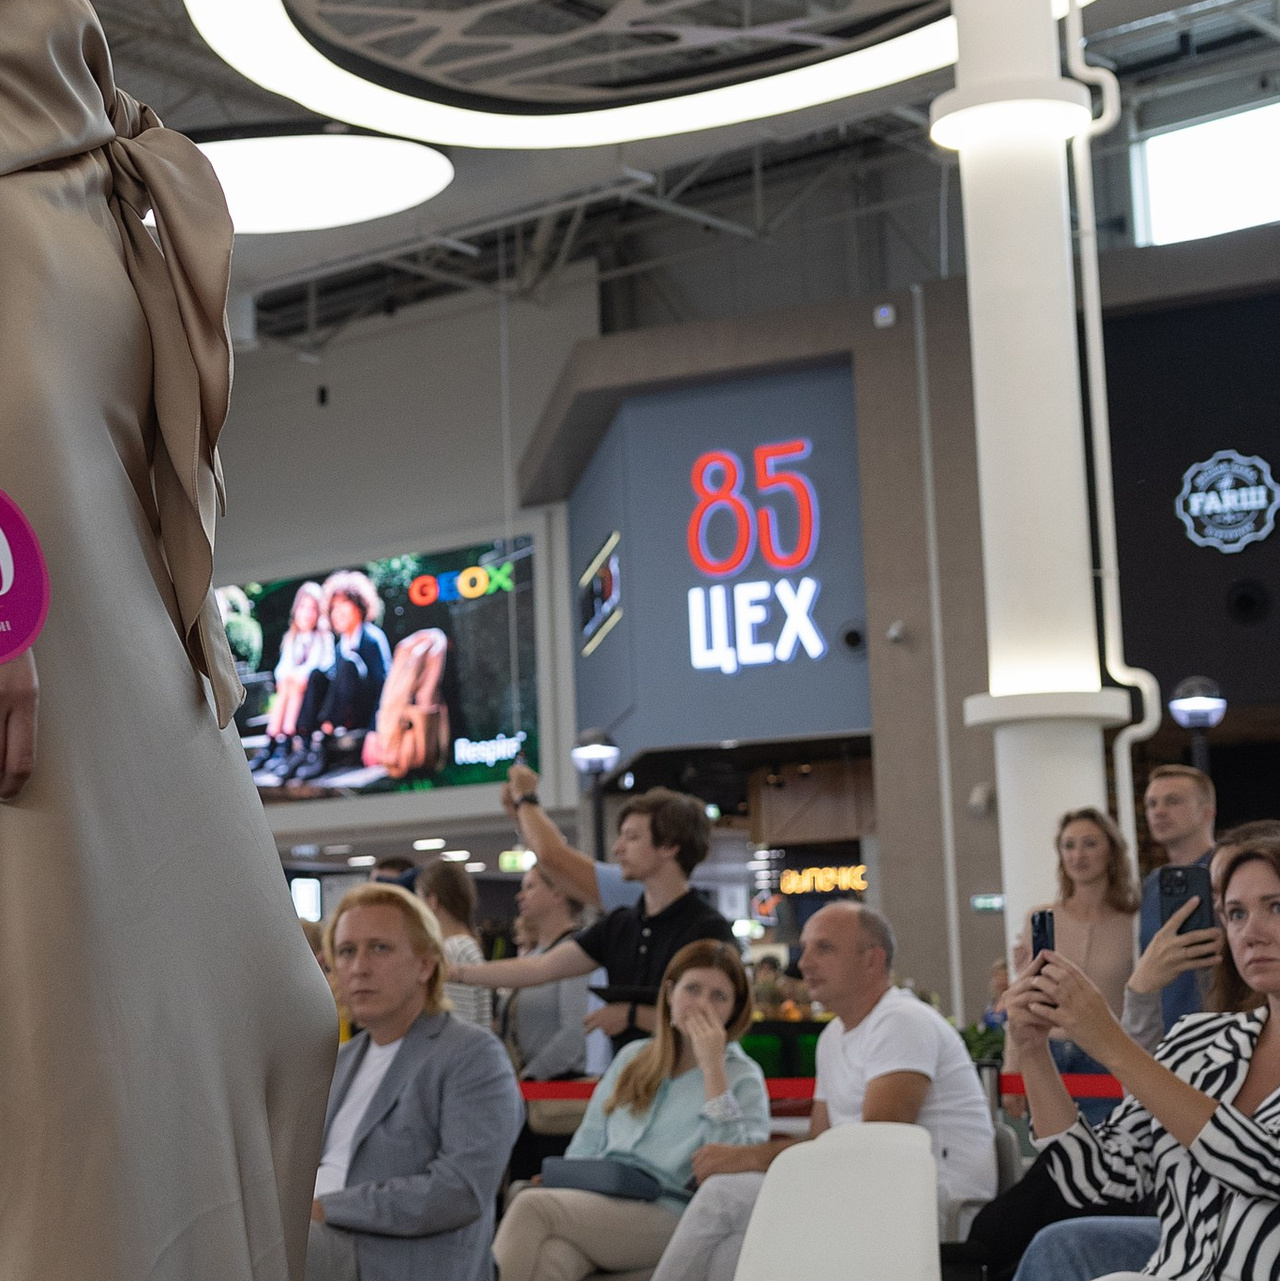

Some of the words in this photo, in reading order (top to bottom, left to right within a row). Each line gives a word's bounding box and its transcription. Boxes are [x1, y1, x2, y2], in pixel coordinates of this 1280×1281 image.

[688, 439, 820, 576] 85
[409, 561, 514, 606] GEOX
[687, 577, 826, 675] ЦЕХ
